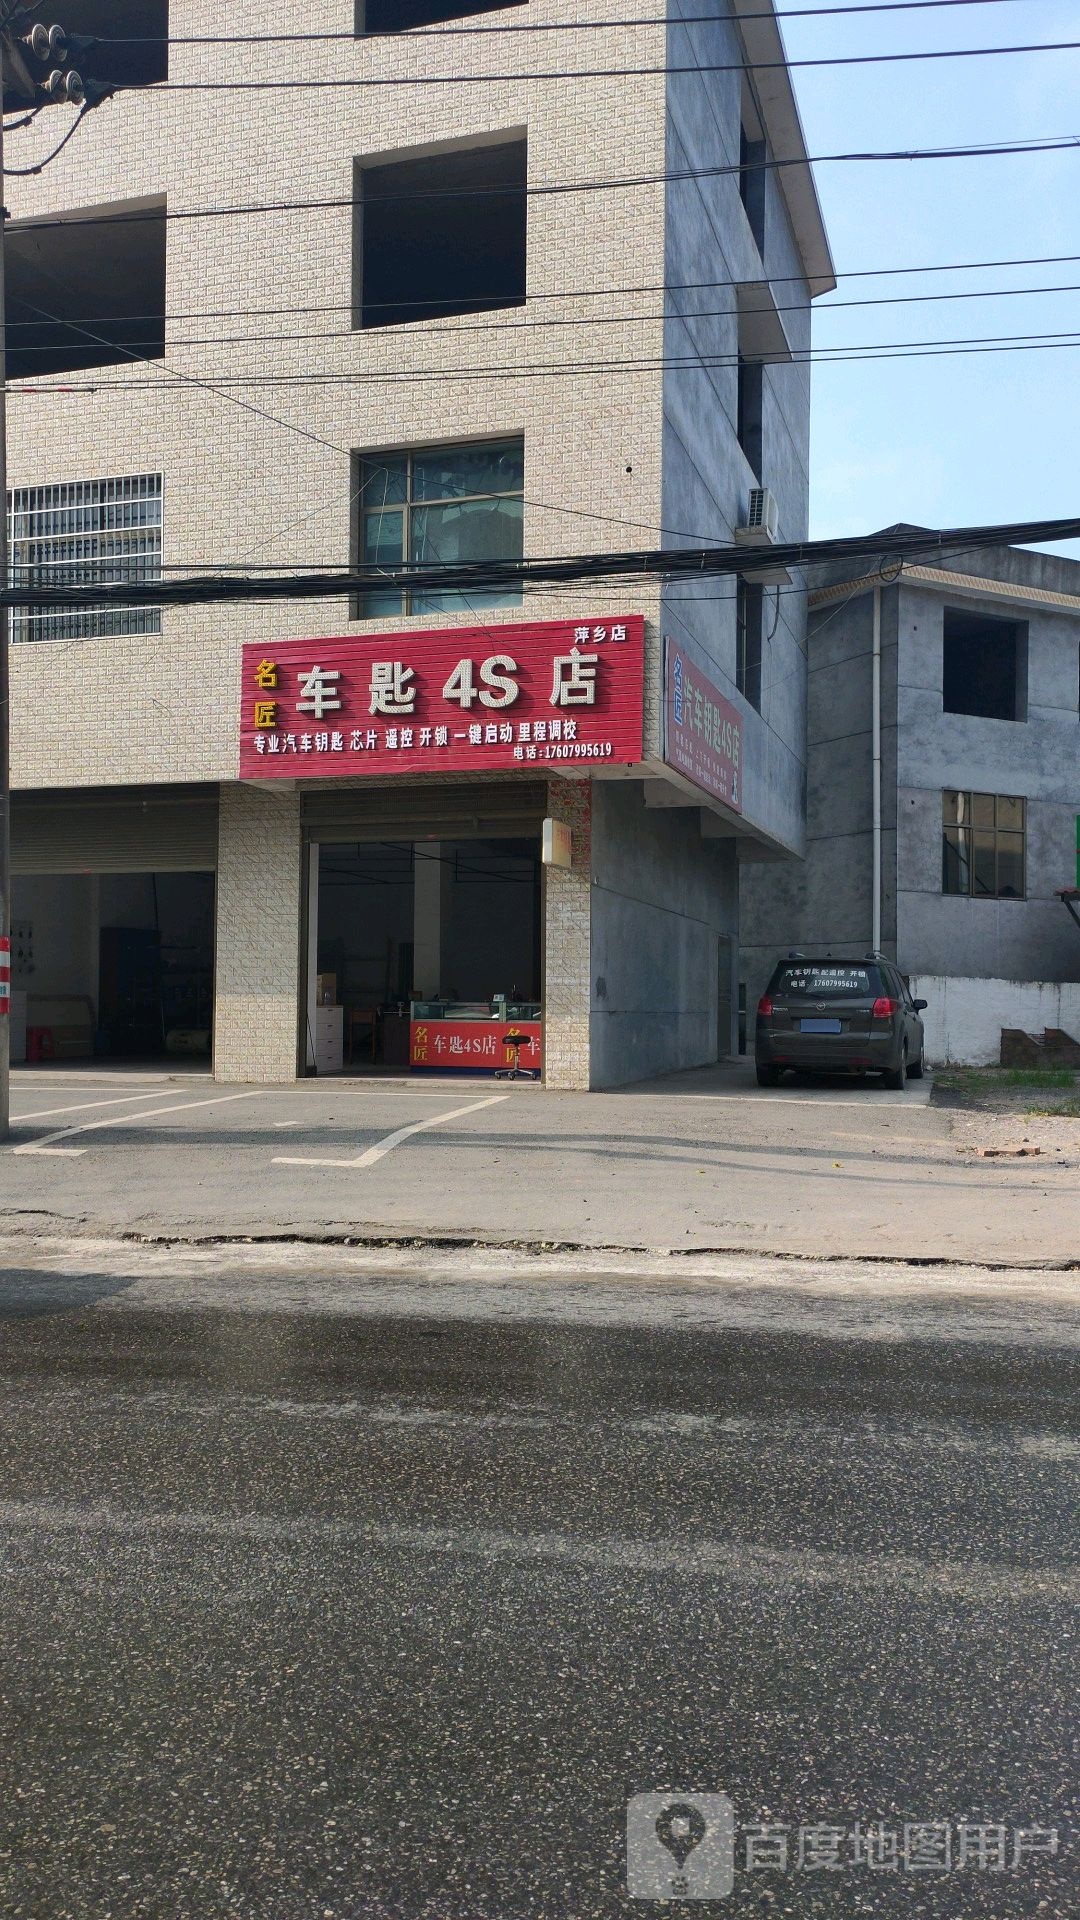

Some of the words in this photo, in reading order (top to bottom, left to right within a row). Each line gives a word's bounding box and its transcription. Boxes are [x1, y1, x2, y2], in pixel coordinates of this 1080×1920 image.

[574, 624, 627, 643] 萍乡店
[254, 659, 278, 728] 名匠
[295, 647, 599, 719] 车匙4S店
[673, 653, 683, 726] 名匠
[254, 731, 343, 754] 专业汽车钥匙
[350, 729, 378, 751] 芯片
[385, 727, 413, 749] 遥控
[420, 725, 448, 746] 开锁
[454, 722, 513, 745] 一键启动
[518, 719, 577, 742] 里程调校
[683, 674, 740, 770] 汽车钥匙4S店
[813, 980, 858, 988] 17607995619
[413, 1026, 428, 1062] 名匠
[432, 1034, 497, 1056] 车匙4S店
